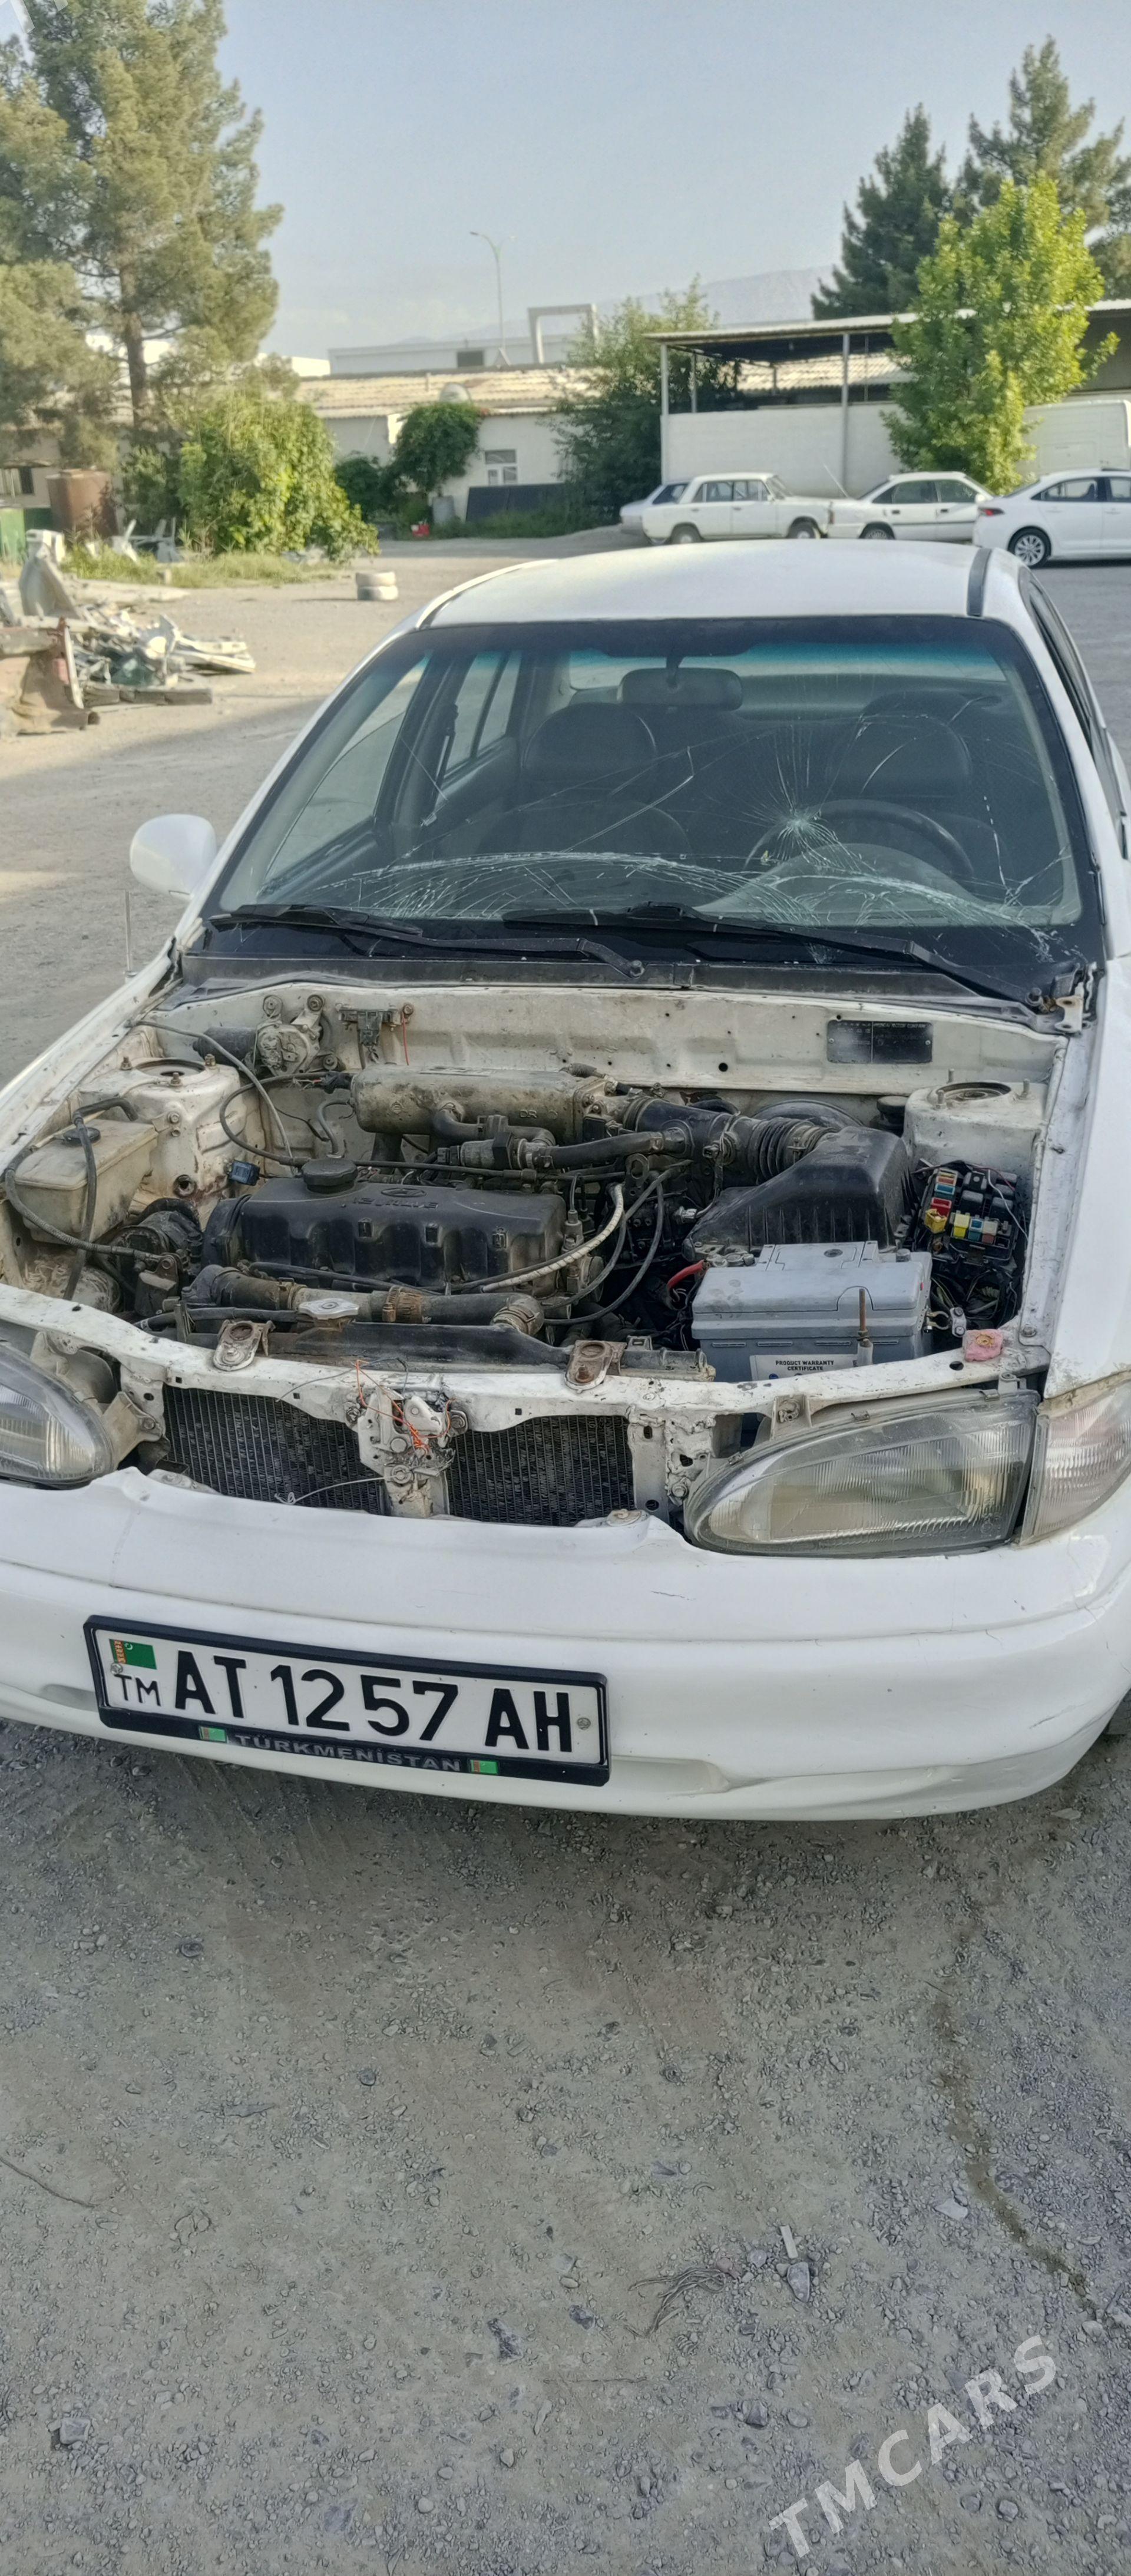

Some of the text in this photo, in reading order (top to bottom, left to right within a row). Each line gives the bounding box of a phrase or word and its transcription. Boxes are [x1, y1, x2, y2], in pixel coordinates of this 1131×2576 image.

[114, 1674, 161, 1707] TM
[175, 1649, 573, 1752] AT 1257 AH
